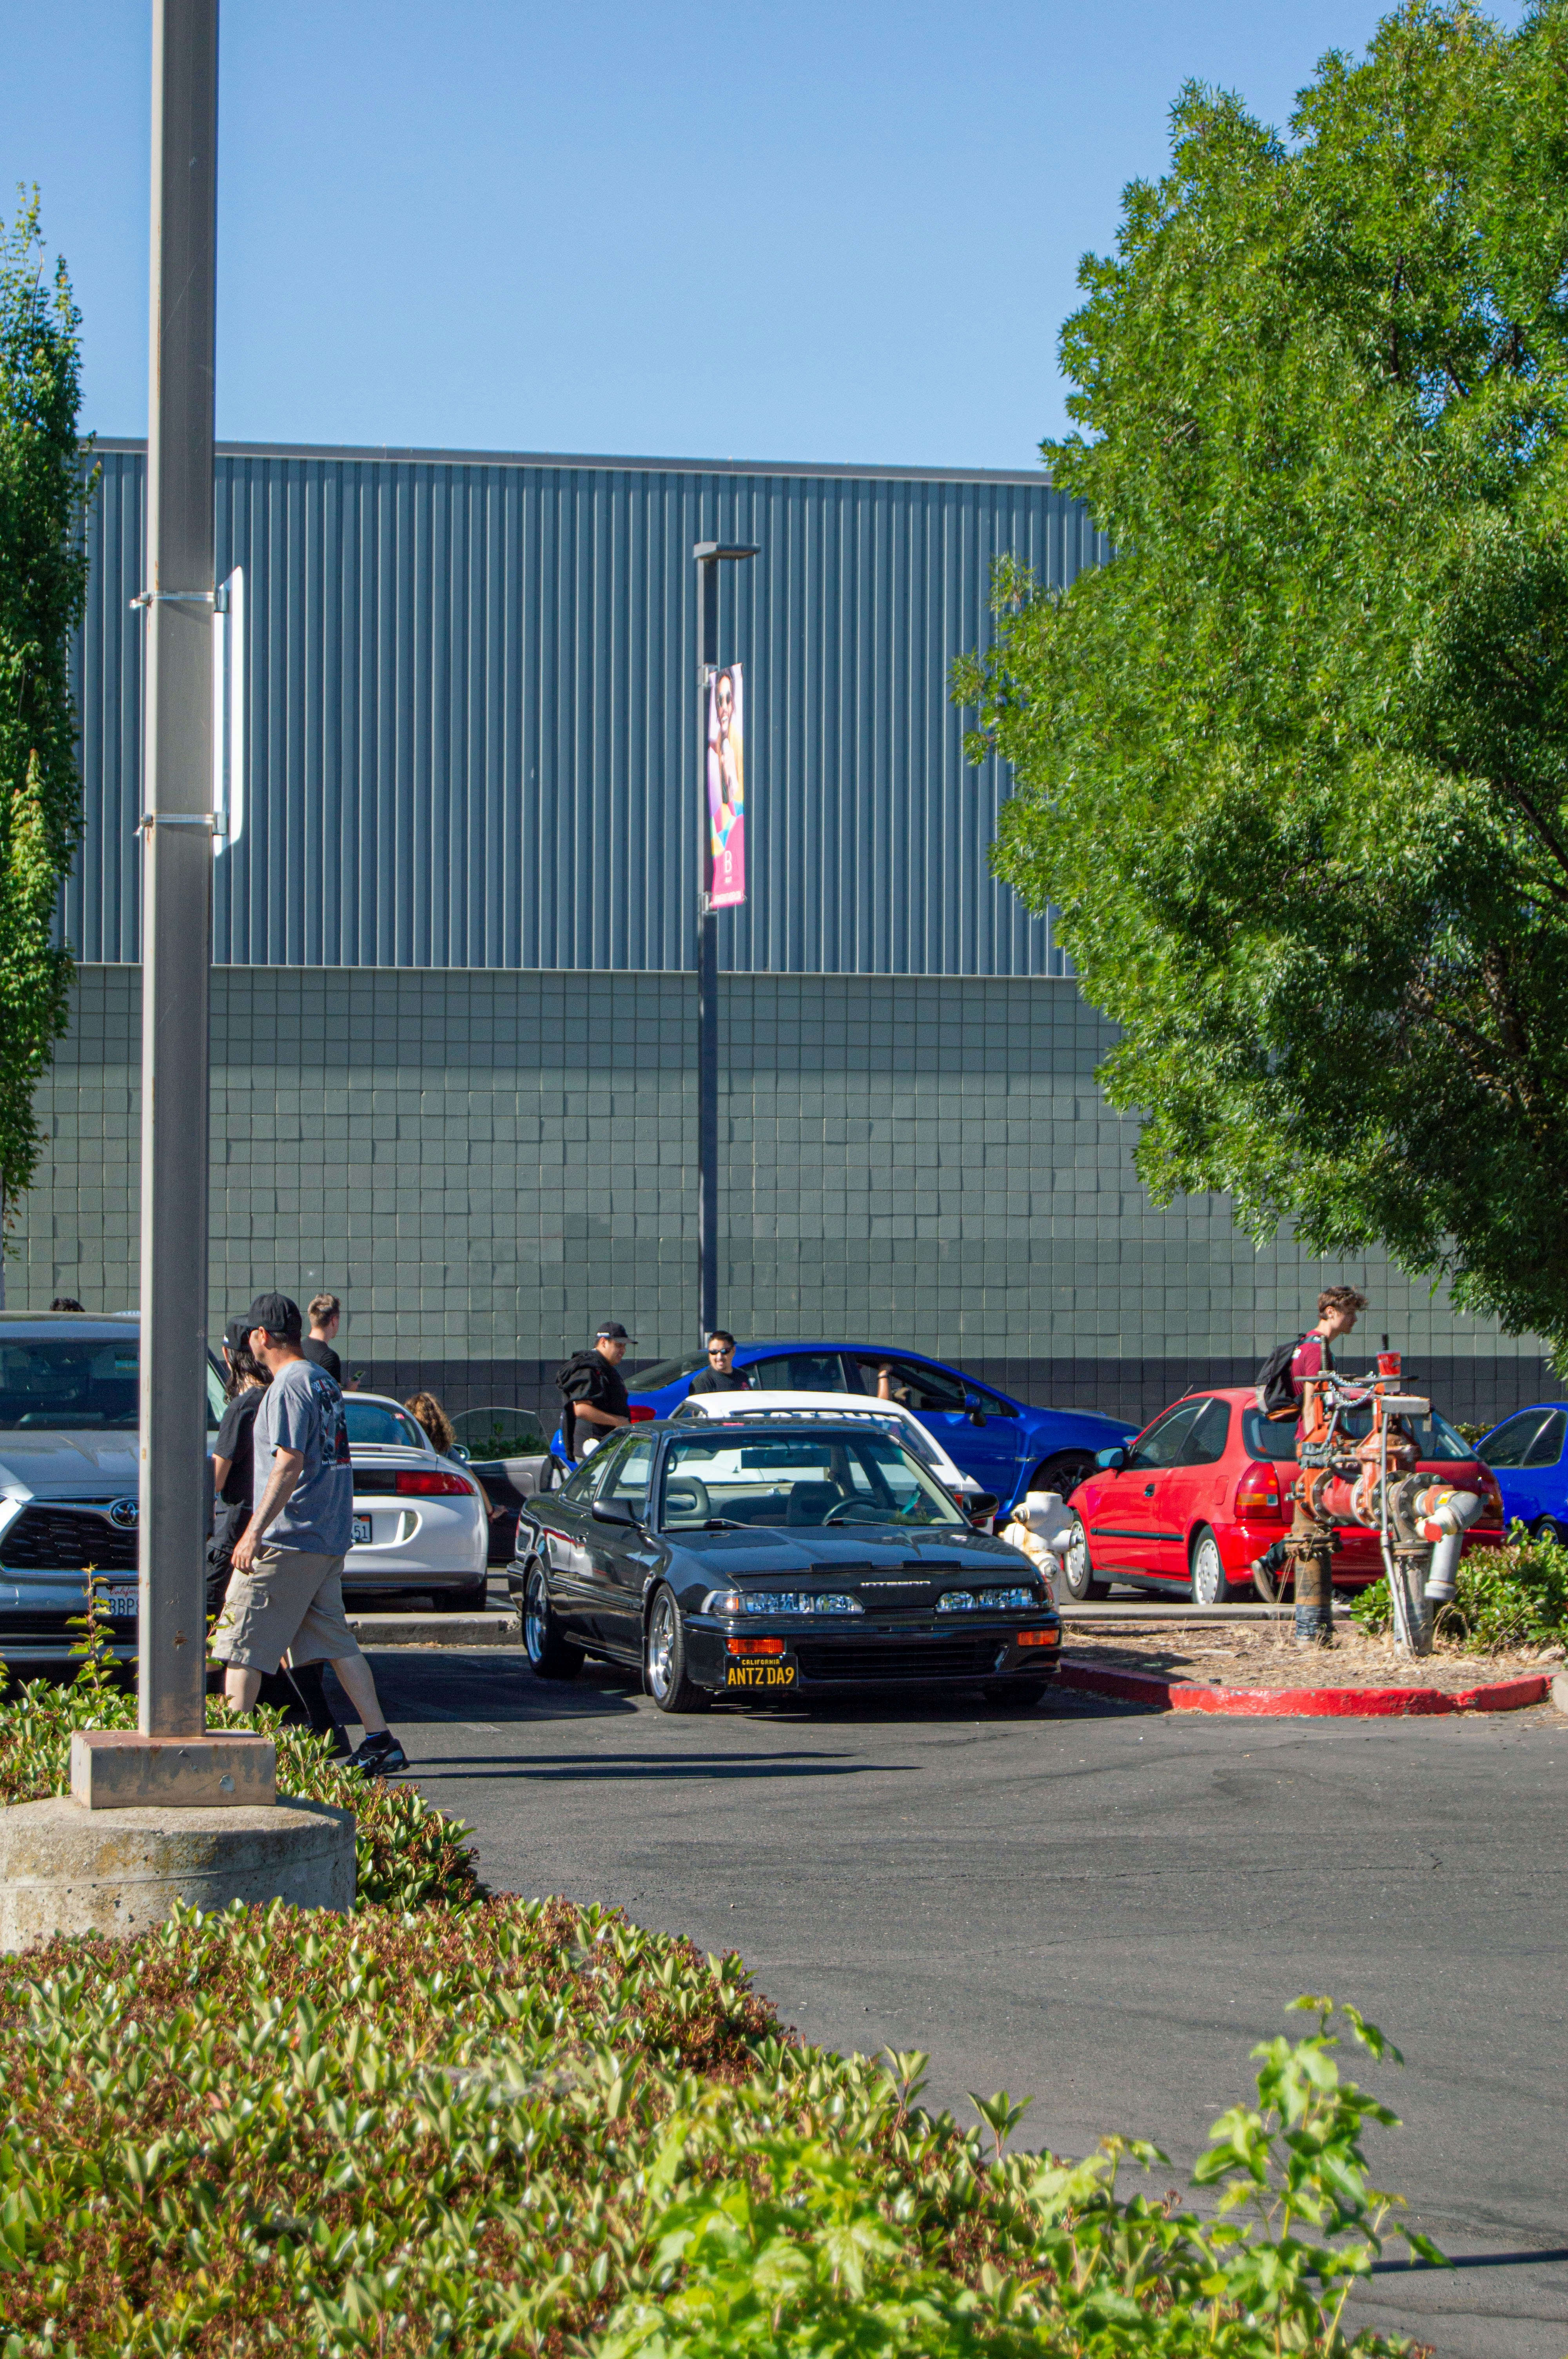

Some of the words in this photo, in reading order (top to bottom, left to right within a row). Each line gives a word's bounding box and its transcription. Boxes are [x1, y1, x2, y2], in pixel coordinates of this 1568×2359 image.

[351, 1525, 368, 1539] 51
[99, 1598, 139, 1615] BBP
[728, 1668, 764, 1685] ANTZ
[767, 1667, 794, 1684] DA9
